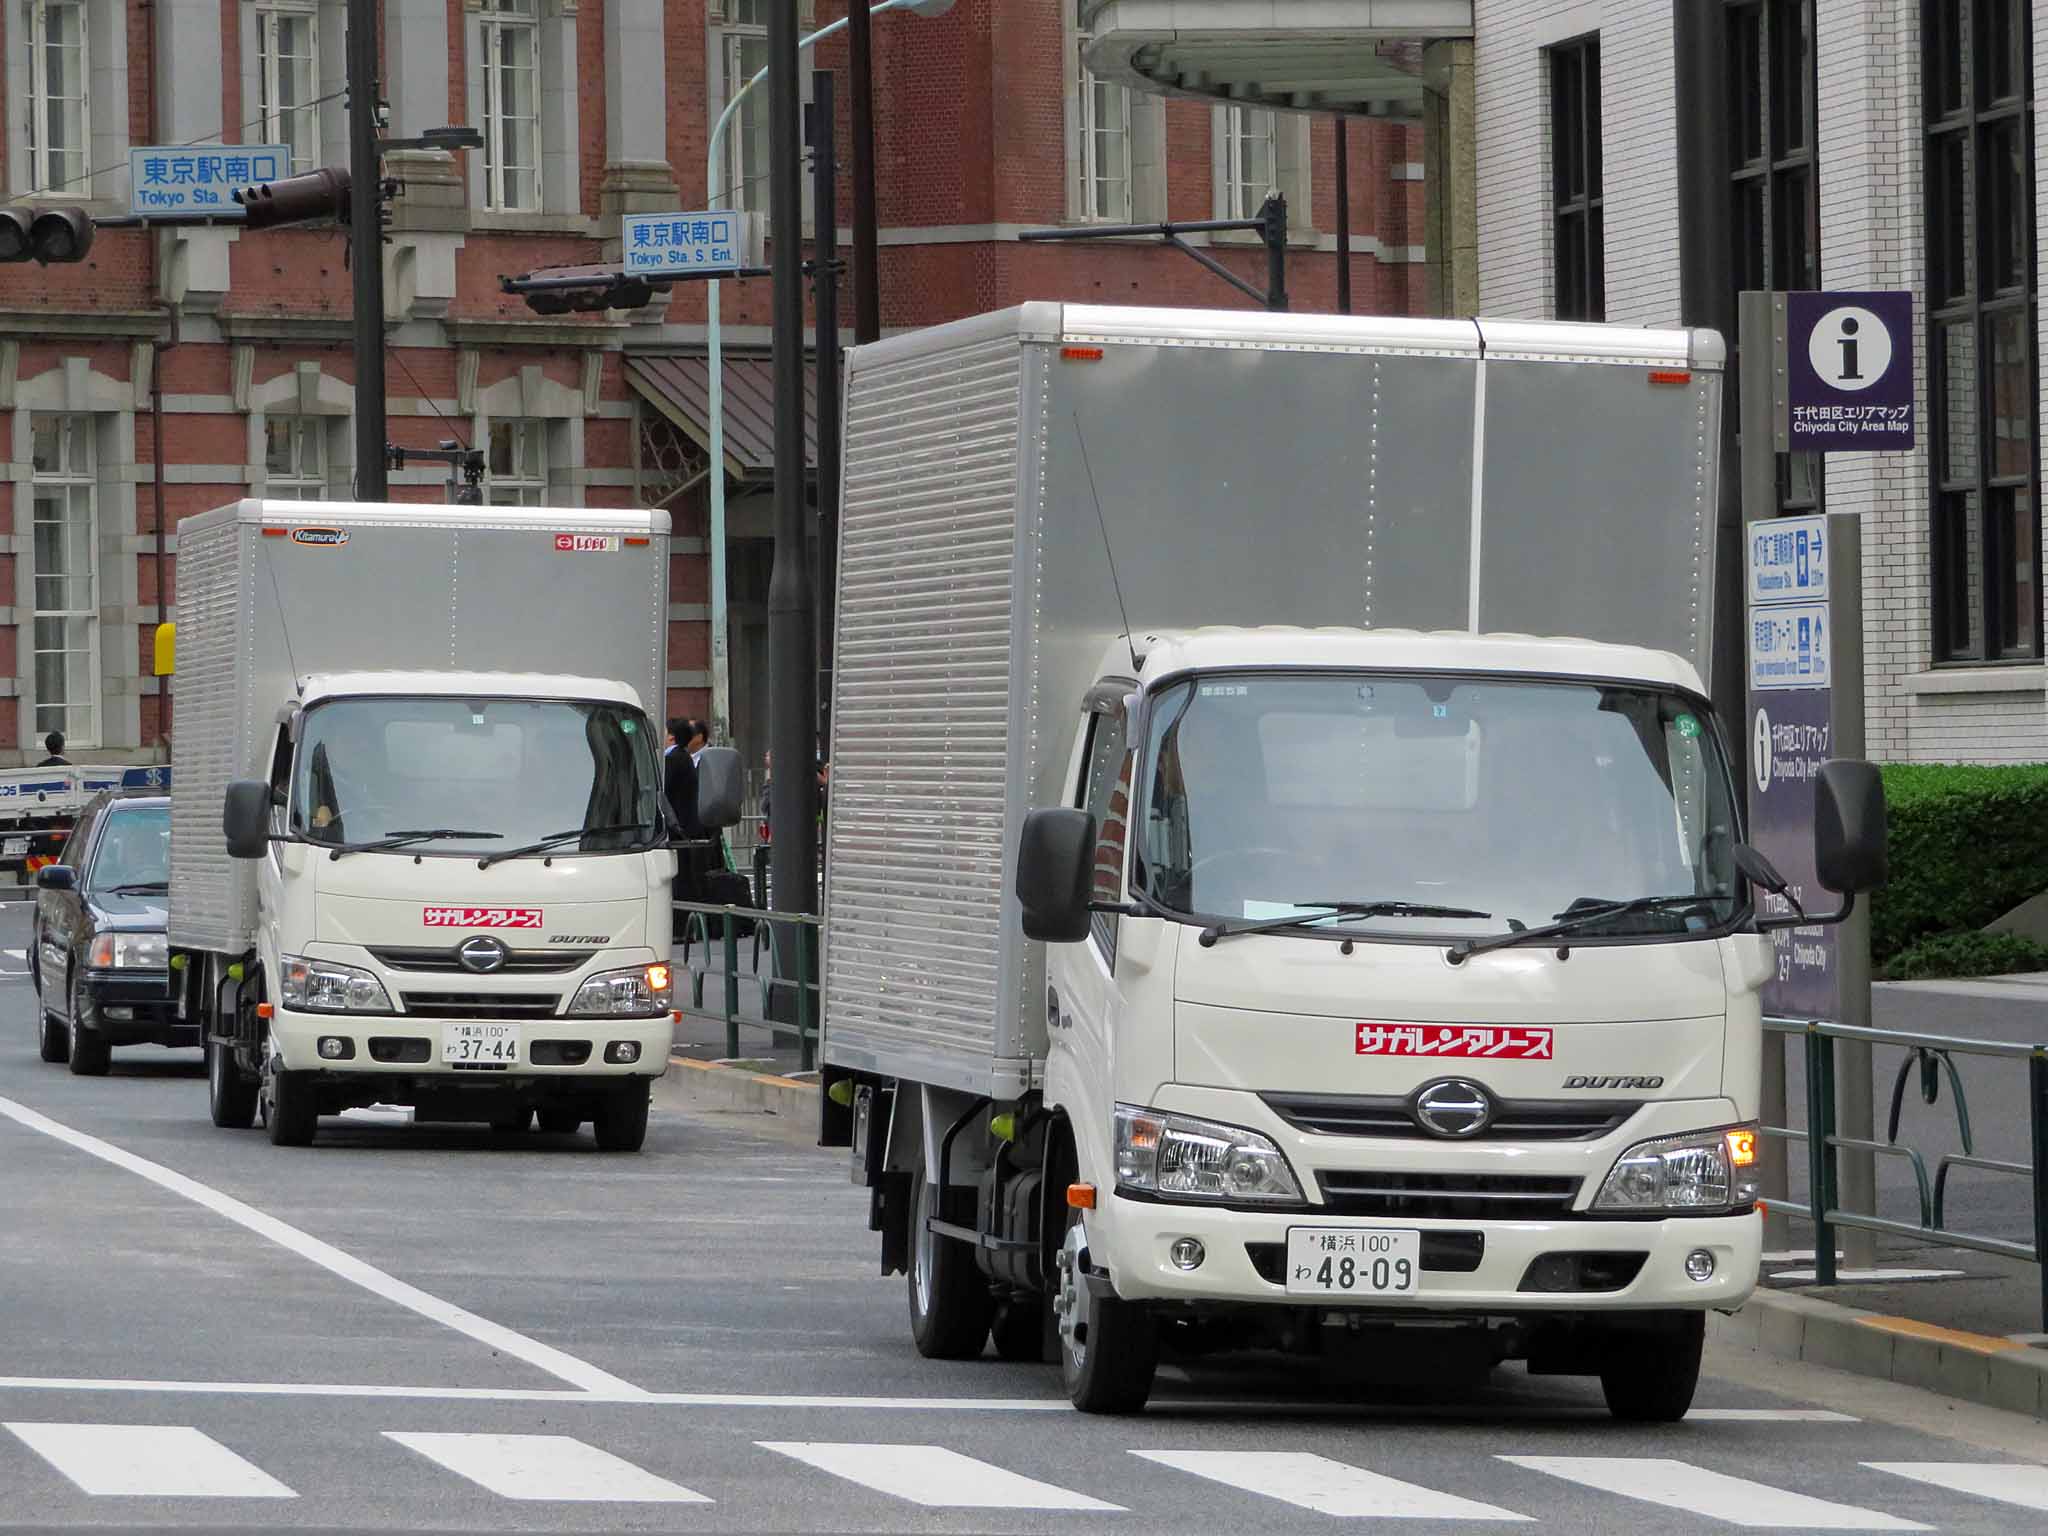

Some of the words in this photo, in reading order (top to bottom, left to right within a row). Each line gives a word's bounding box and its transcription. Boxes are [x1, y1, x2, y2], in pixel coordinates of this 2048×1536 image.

[143, 156, 276, 185] 東京駅南口
[138, 190, 185, 208] Tokyo
[192, 188, 222, 205] Sta.
[632, 220, 729, 248] 東京駅南口
[629, 252, 663, 267] Tokyo
[668, 249, 690, 263] Sta.
[711, 248, 735, 261] Ent.
[1793, 404, 1910, 421] 千代田区エリアマップ
[1793, 421, 1836, 435] Chiyoda
[1838, 421, 1859, 435] City
[1861, 421, 1885, 433] Area
[1887, 420, 1909, 434] Map
[1772, 721, 1829, 753] 千代田区エリアマップ
[1773, 756, 1795, 783] Chiyoda
[1795, 756, 1807, 783] City
[425, 908, 542, 927] サガレンタリース
[548, 934, 610, 944] DUTRO
[1793, 943, 1815, 971] Chiyoda
[1815, 943, 1826, 972] City
[1778, 954, 1791, 982] 2-7
[486, 1026, 505, 1038] 100
[1358, 1026, 1550, 1056] サガレンタリース
[459, 1039, 516, 1060] 37-44
[1561, 1075, 1666, 1089] DUTRO
[1320, 1235, 1356, 1252] 横浜
[1361, 1234, 1391, 1253] 100
[1295, 1263, 1313, 1281] わ
[1316, 1256, 1412, 1291] 48-09
